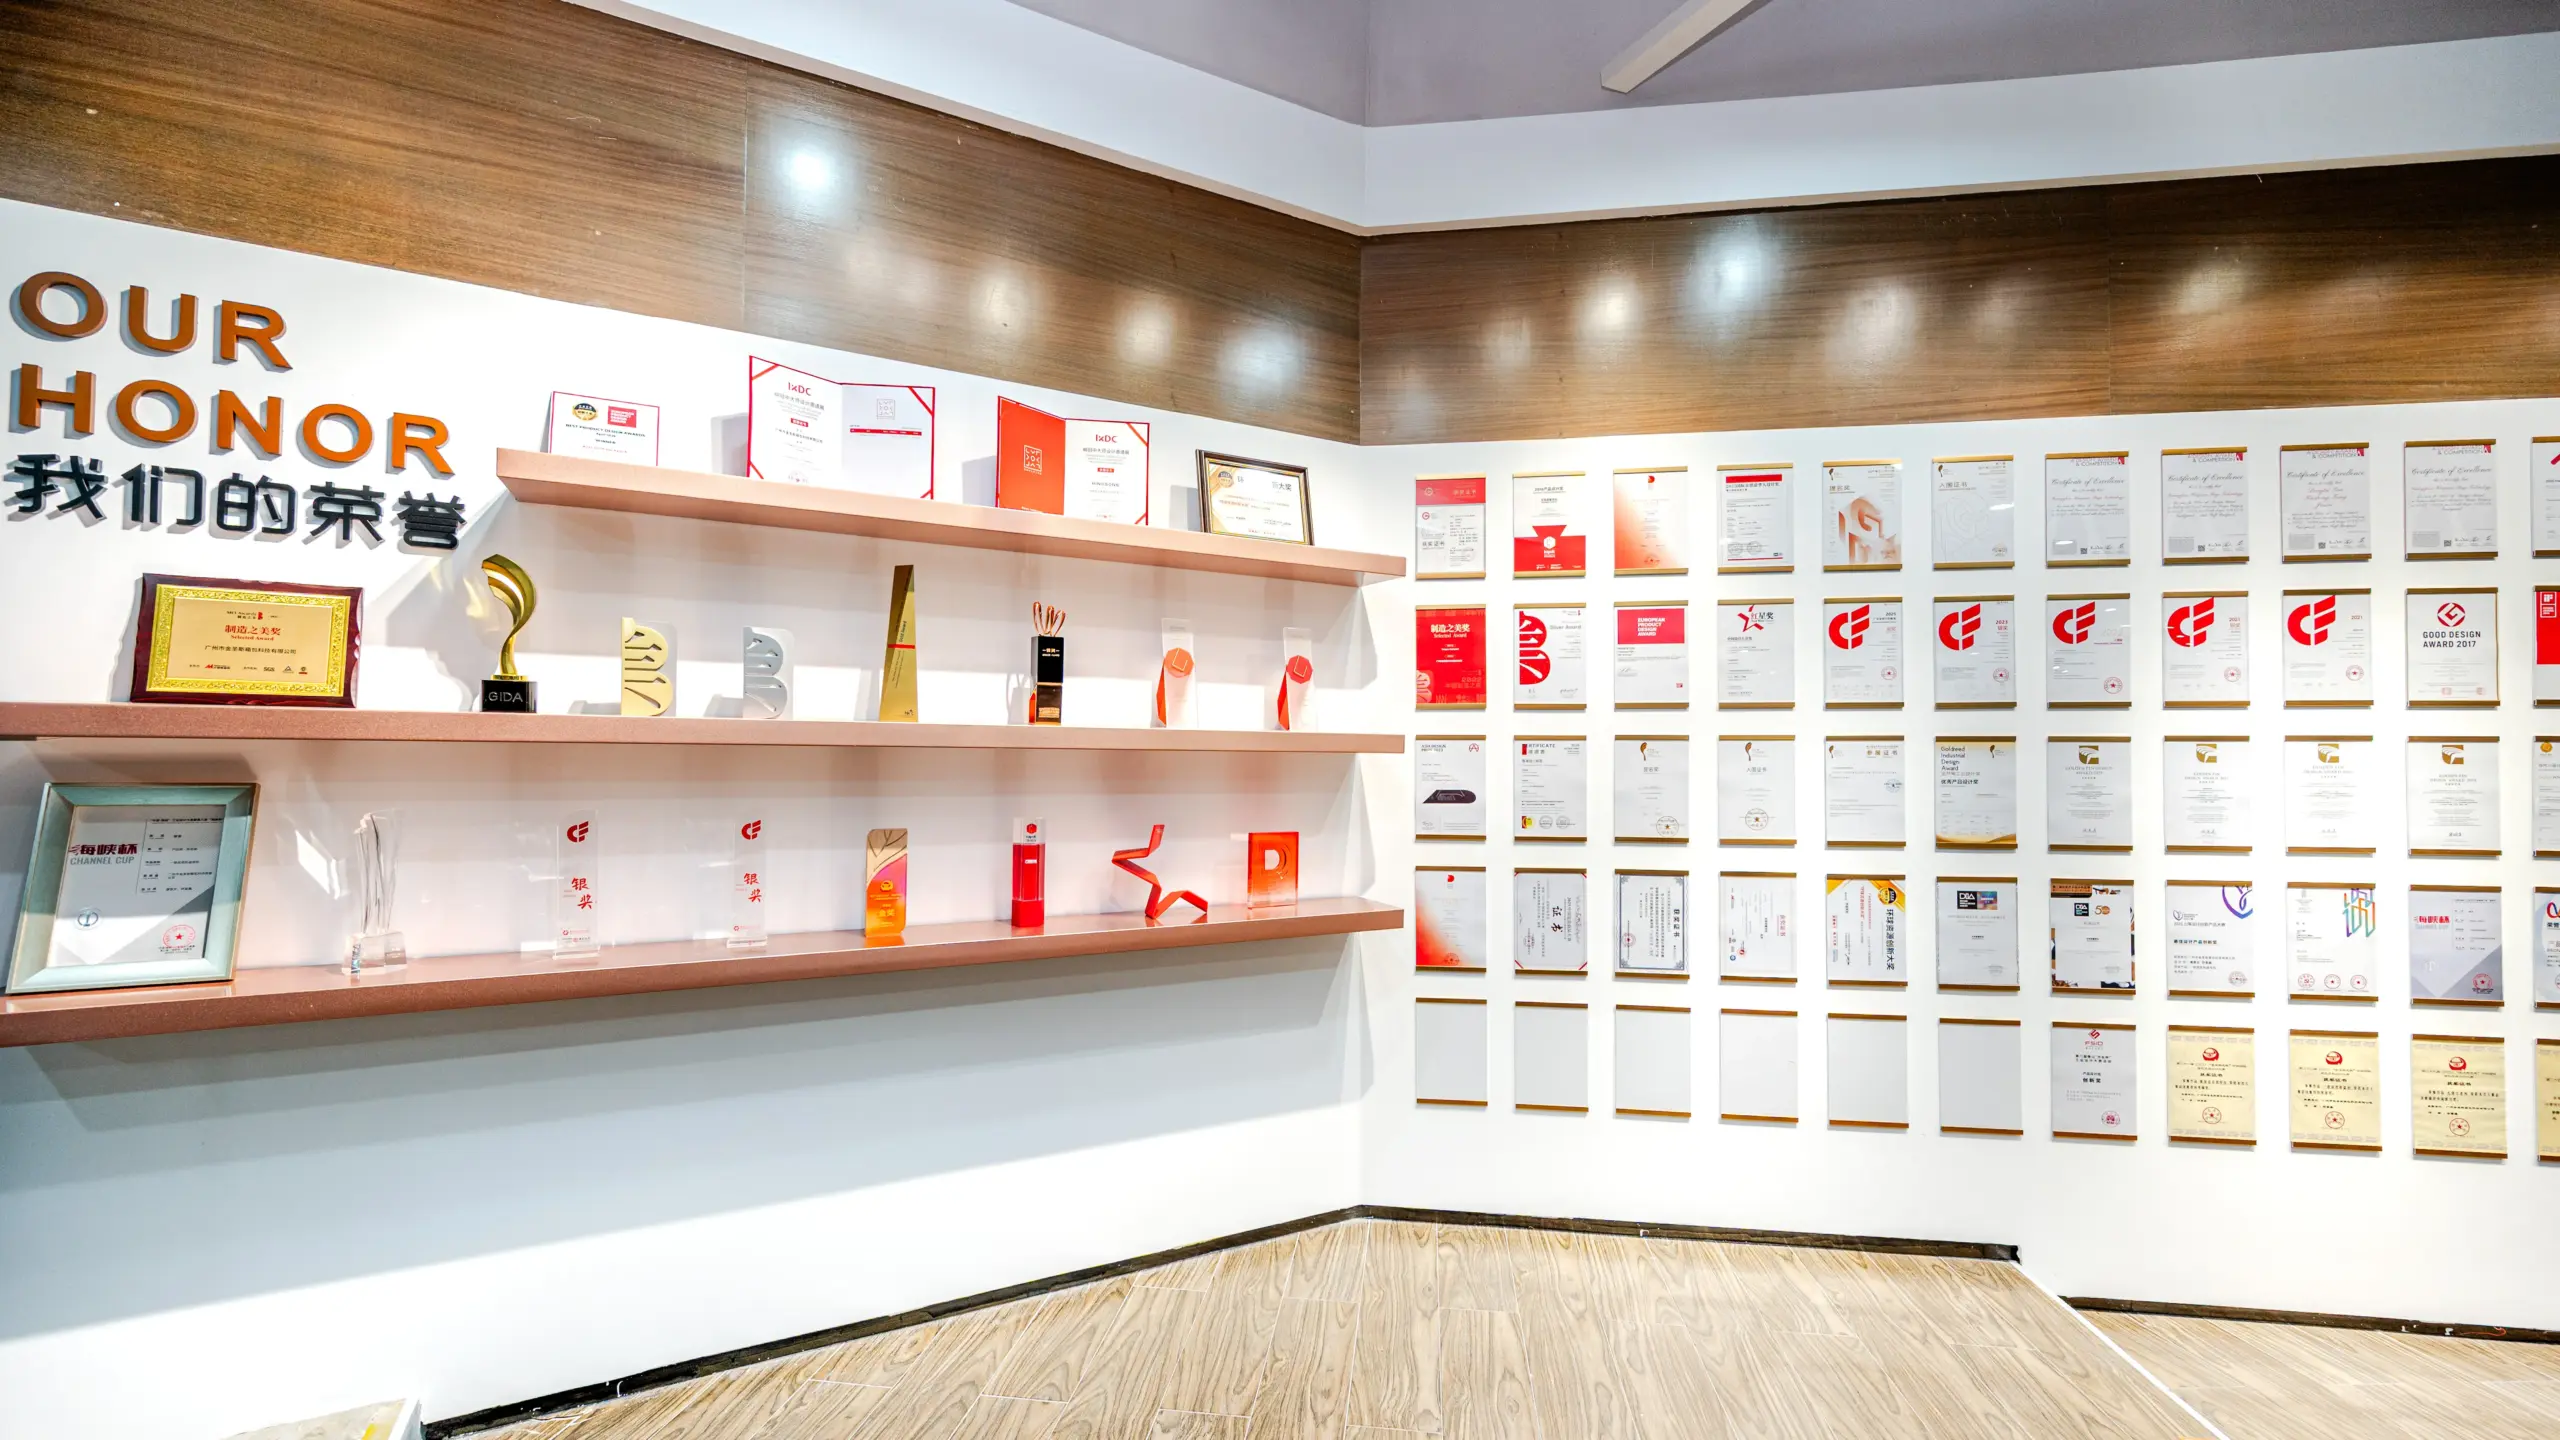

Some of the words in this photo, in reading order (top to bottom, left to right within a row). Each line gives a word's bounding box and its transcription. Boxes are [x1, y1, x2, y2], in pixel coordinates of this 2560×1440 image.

[19, 271, 293, 370] OUR
[18, 363, 455, 475] HONOR
[13, 453, 468, 550] 我们的荣誉
[1751, 612, 1774, 620] 红星奖
[224, 624, 281, 636] 制造之美奖
[1430, 624, 1470, 633] 制造之美奖
[2422, 631, 2447, 639] GOOD
[2449, 630, 2482, 639] DESIGN
[2422, 640, 2454, 648] AWARD
[2456, 640, 2476, 648] 2017
[488, 691, 523, 703] GIDA
[70, 856, 113, 865] CHANNEL
[115, 855, 135, 865] CUP
[1551, 906, 1563, 933] 证书
[1886, 909, 1895, 971] 环球资源创新大奖
